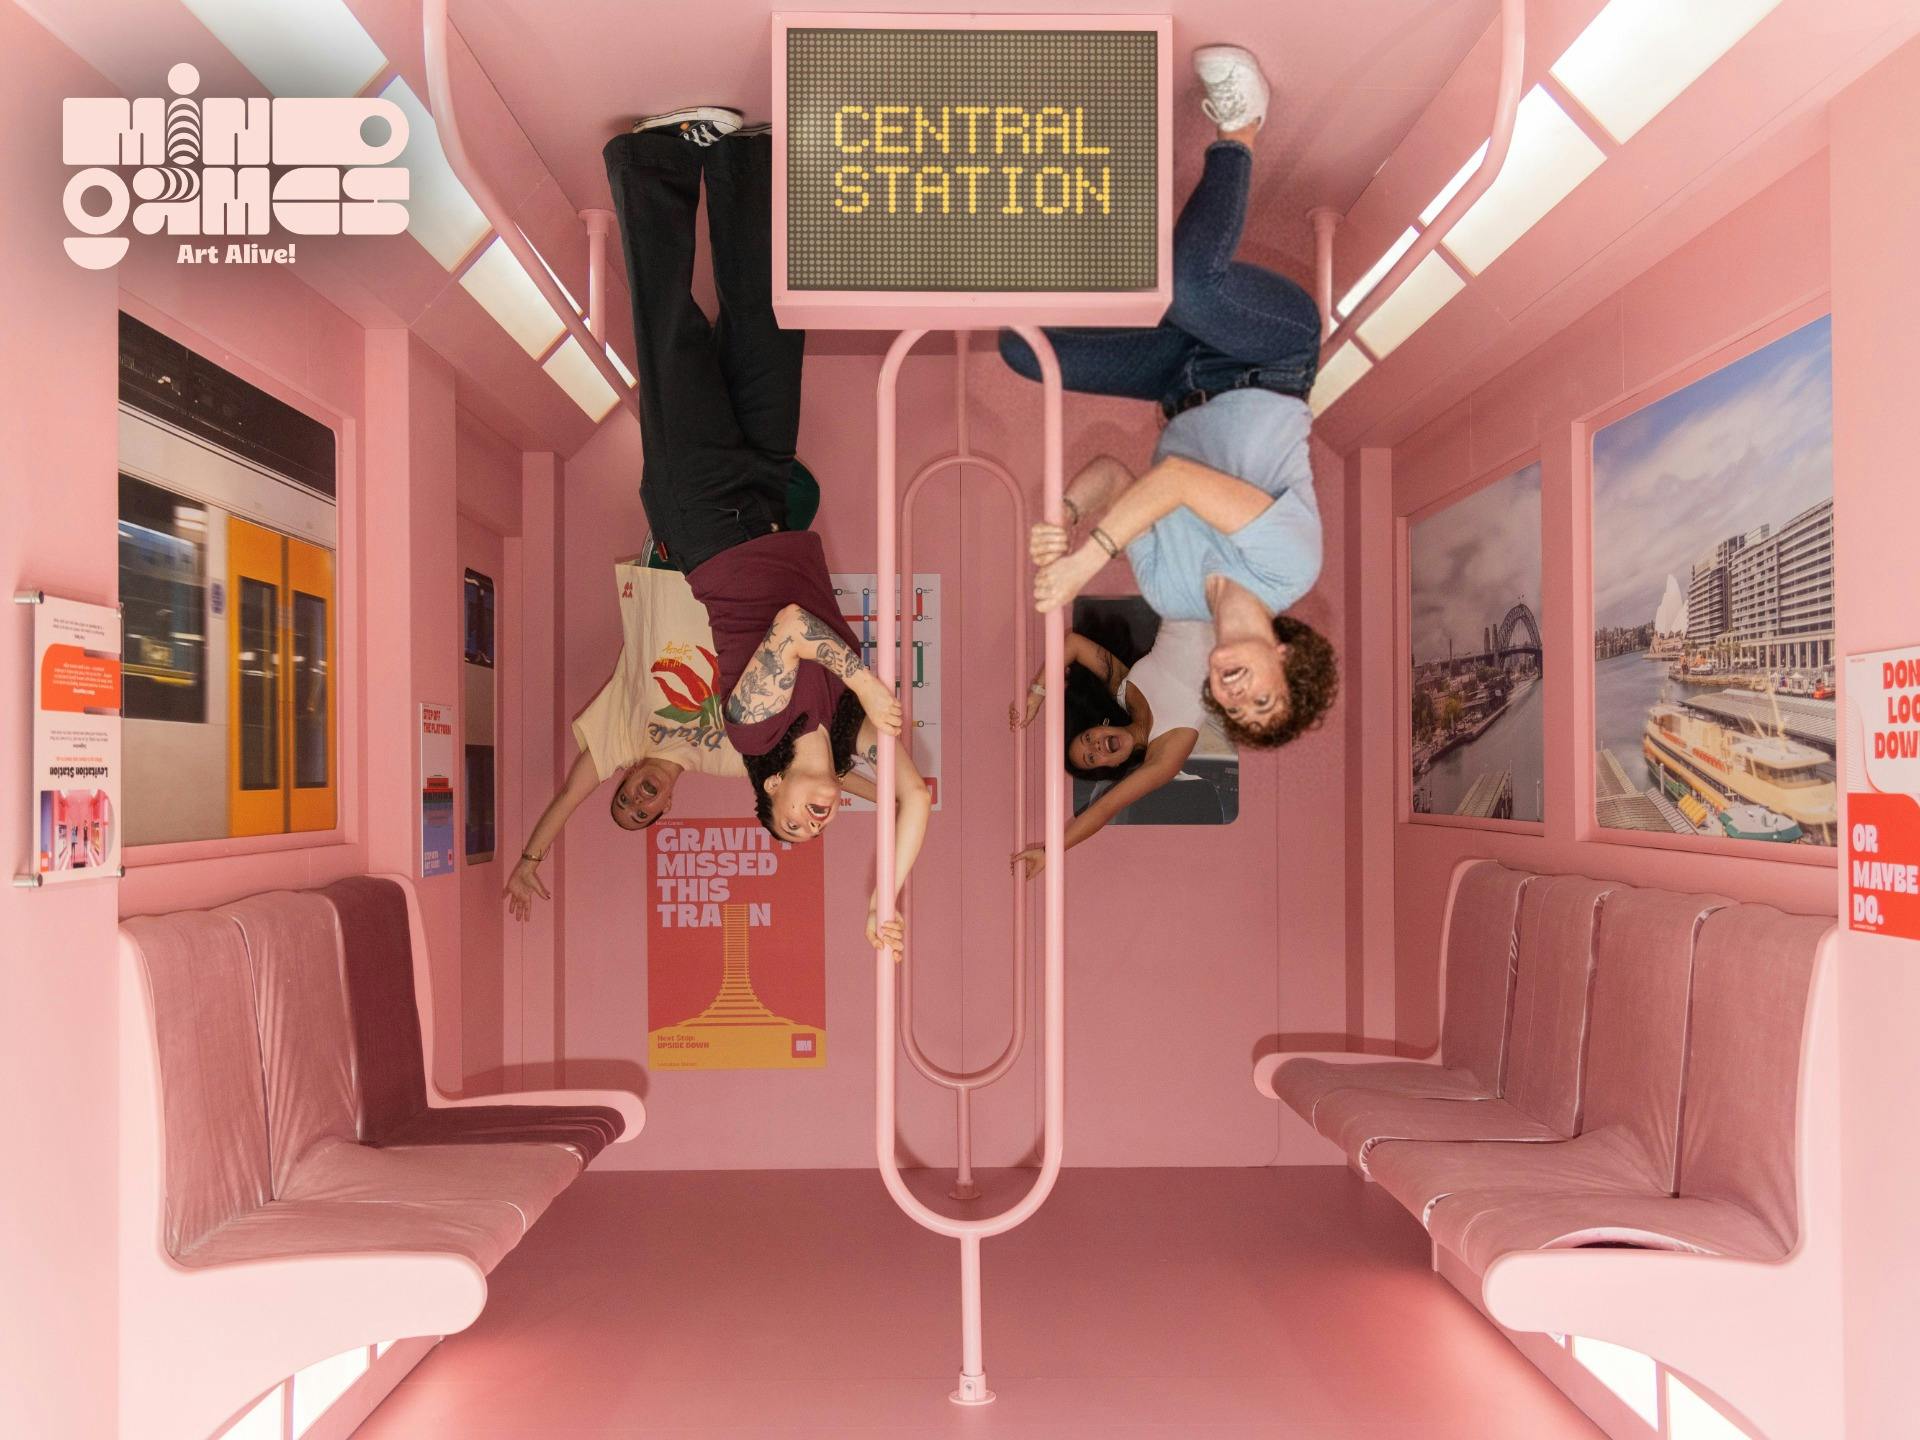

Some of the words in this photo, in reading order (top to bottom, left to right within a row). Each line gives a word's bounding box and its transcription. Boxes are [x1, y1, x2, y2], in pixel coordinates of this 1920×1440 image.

[834, 105, 1110, 154] CENTRAL
[834, 166, 1110, 214] STATION
[1874, 730, 1920, 760] DOW
[49, 766, 75, 779] Station
[75, 766, 109, 779] Levitation
[656, 826, 792, 853] GRAVIT
[1852, 823, 1879, 854] OR
[656, 852, 778, 877] MISSED
[1852, 859, 1919, 895] MAYBE
[656, 877, 730, 903] THIS
[1853, 893, 1884, 926] DO.
[657, 1034, 674, 1042] Next
